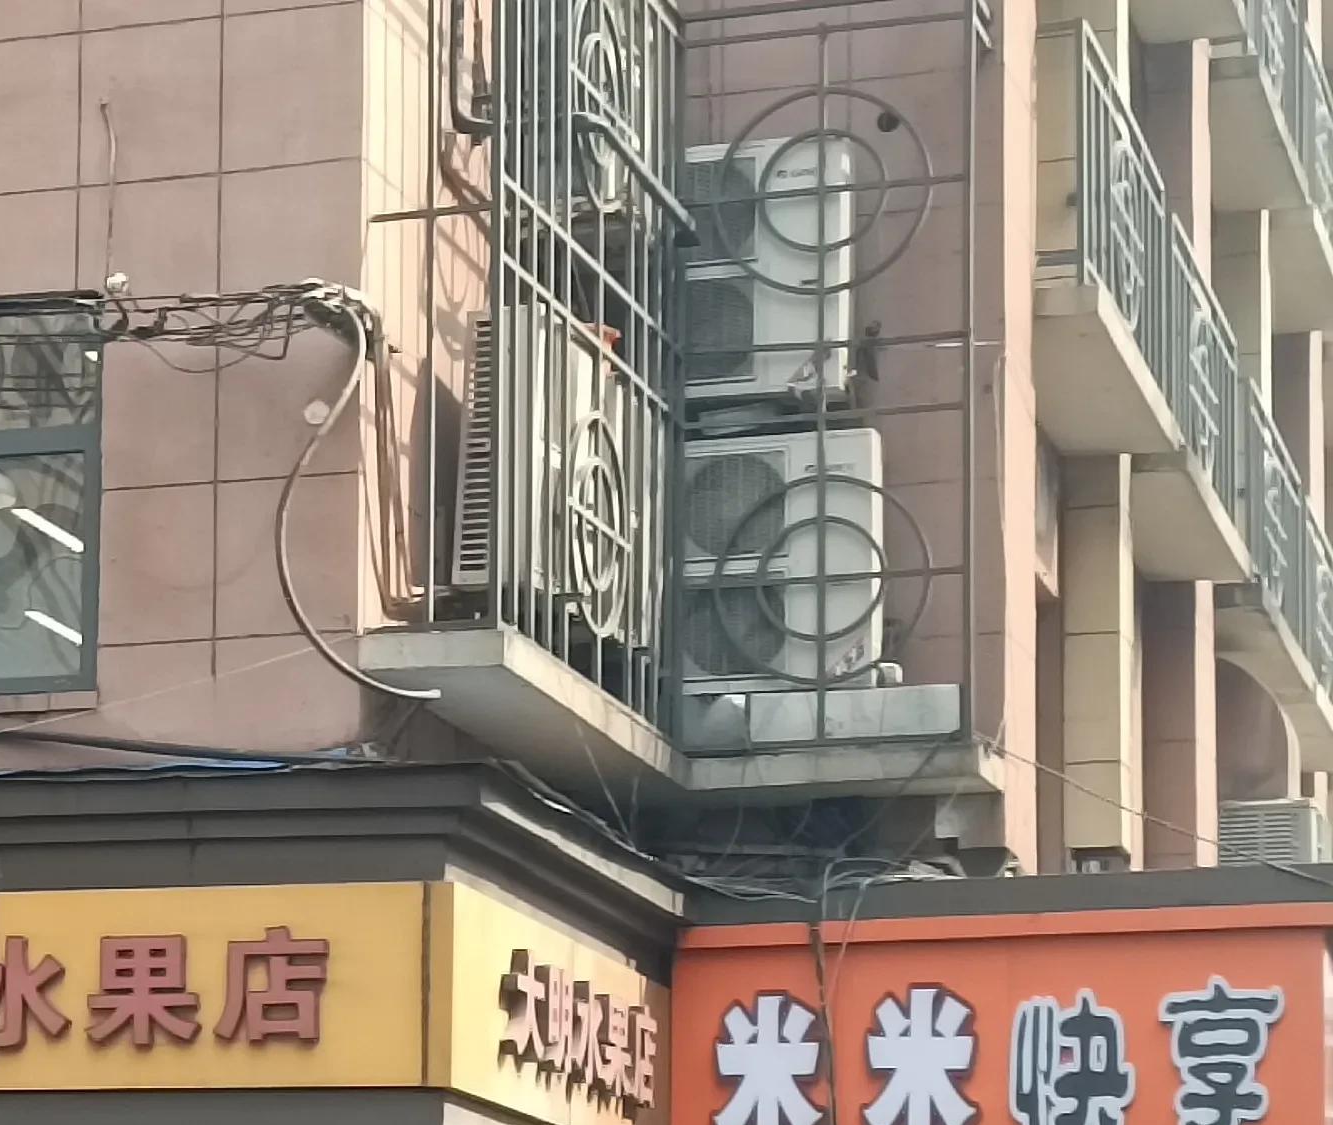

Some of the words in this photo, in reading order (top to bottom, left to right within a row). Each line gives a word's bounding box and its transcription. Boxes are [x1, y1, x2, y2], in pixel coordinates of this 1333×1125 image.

[498, 949, 658, 1108] 大明水果店
